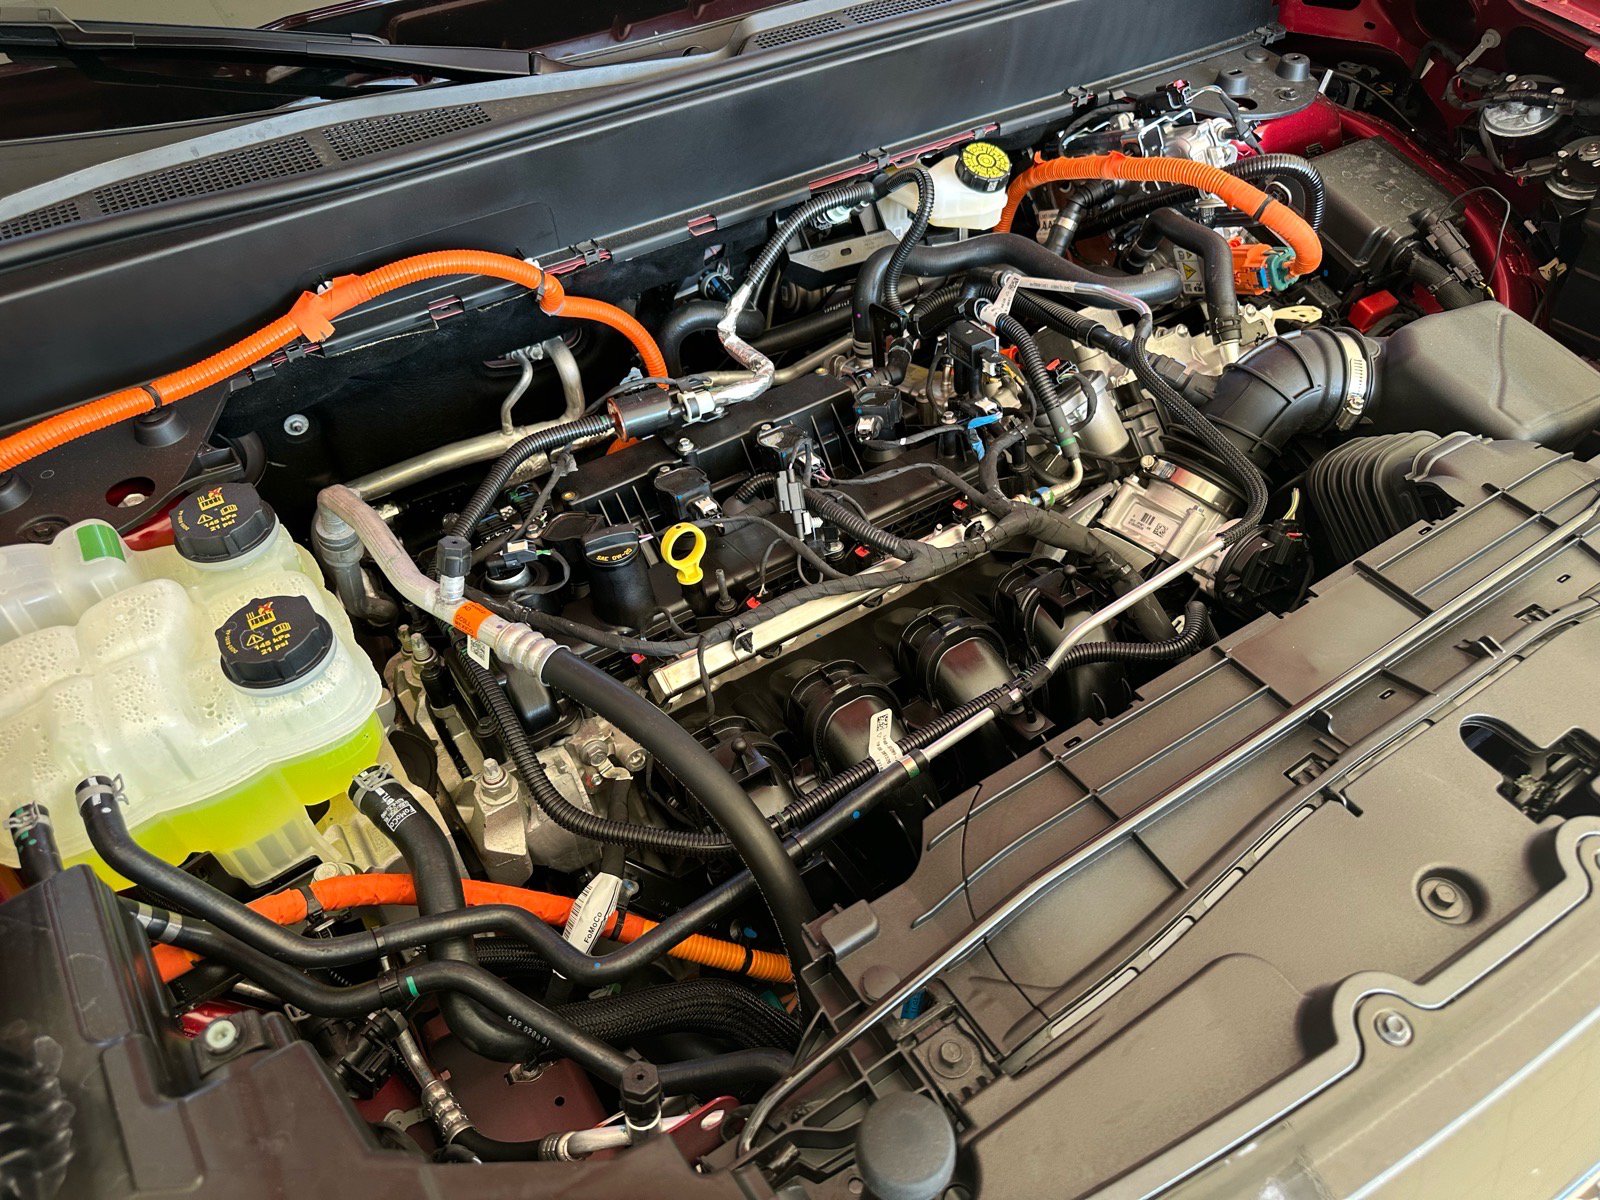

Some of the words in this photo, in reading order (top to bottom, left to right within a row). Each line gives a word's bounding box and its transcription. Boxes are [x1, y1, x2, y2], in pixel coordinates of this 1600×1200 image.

[204, 519, 220, 528] 145
[222, 519, 235, 528] psi
[254, 640, 271, 650] 145
[272, 633, 291, 643] kPa
[261, 647, 272, 655] 21
[274, 639, 289, 651] psi
[583, 911, 603, 944] FoMoCo
